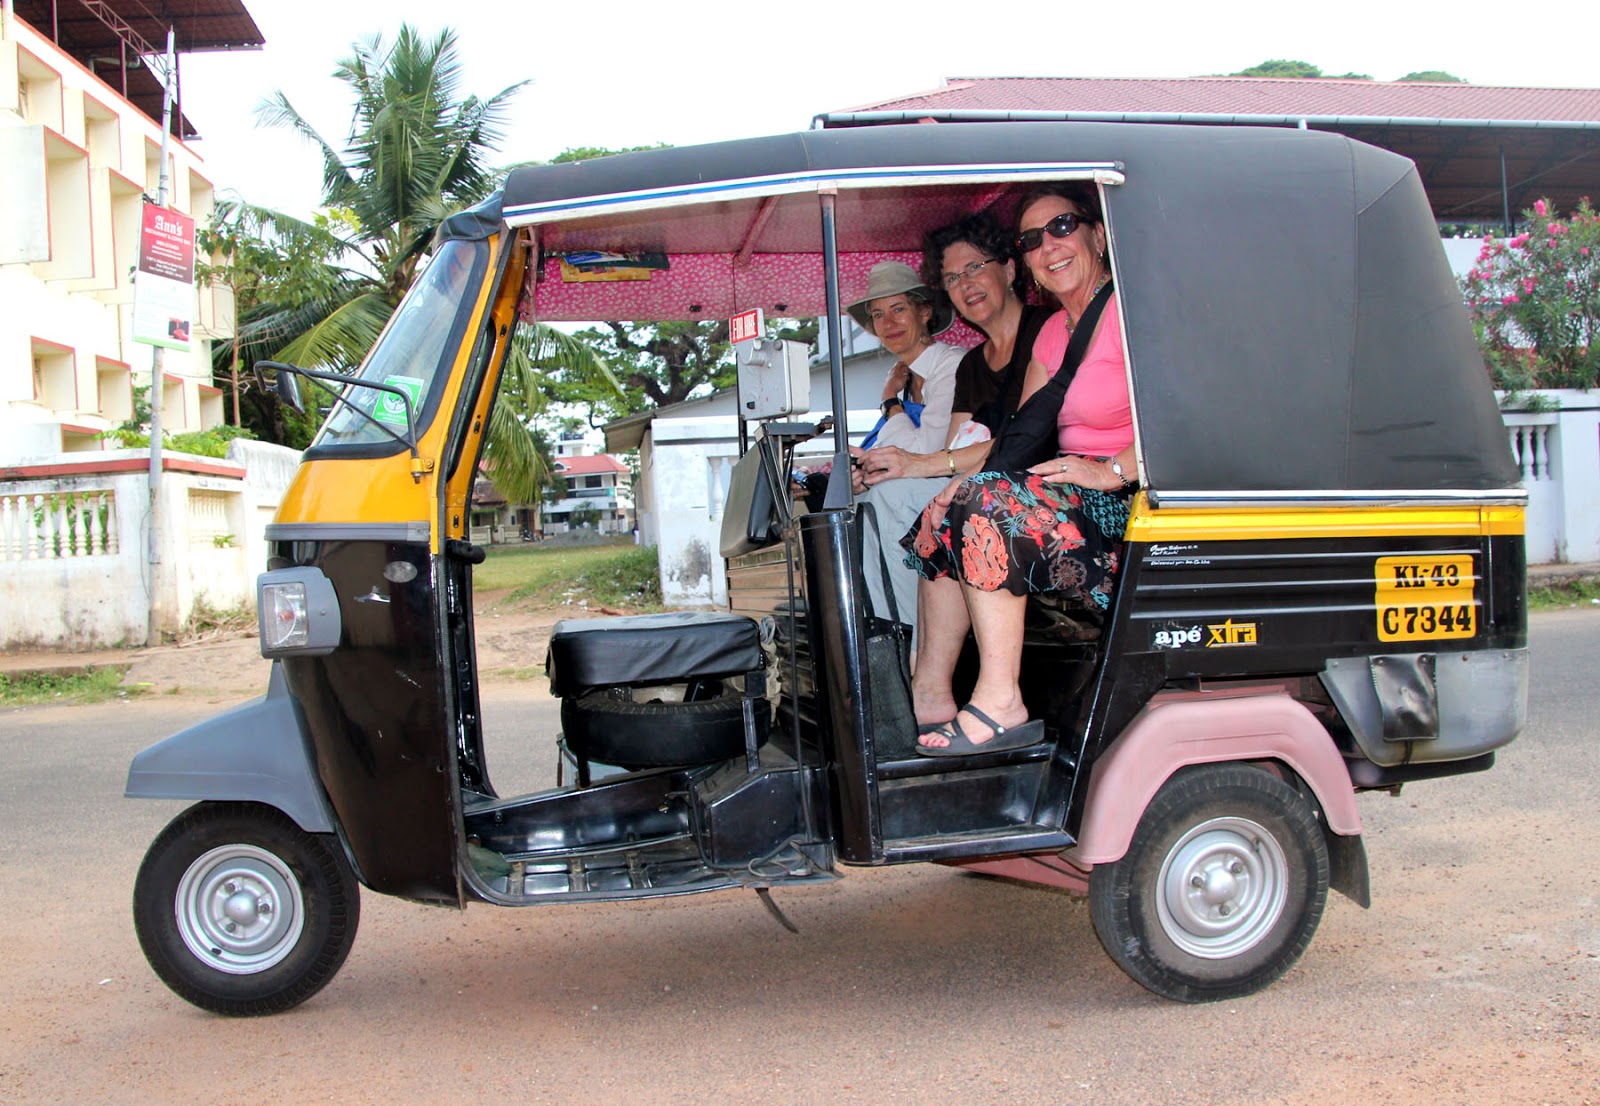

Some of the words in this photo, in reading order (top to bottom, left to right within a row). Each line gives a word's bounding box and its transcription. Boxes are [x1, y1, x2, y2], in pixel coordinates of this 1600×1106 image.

[154, 214, 183, 237] Ann's
[732, 316, 744, 340] FOR
[744, 312, 757, 337] HIRE
[1393, 564, 1460, 588] KL-43
[1155, 625, 1202, 649] apé
